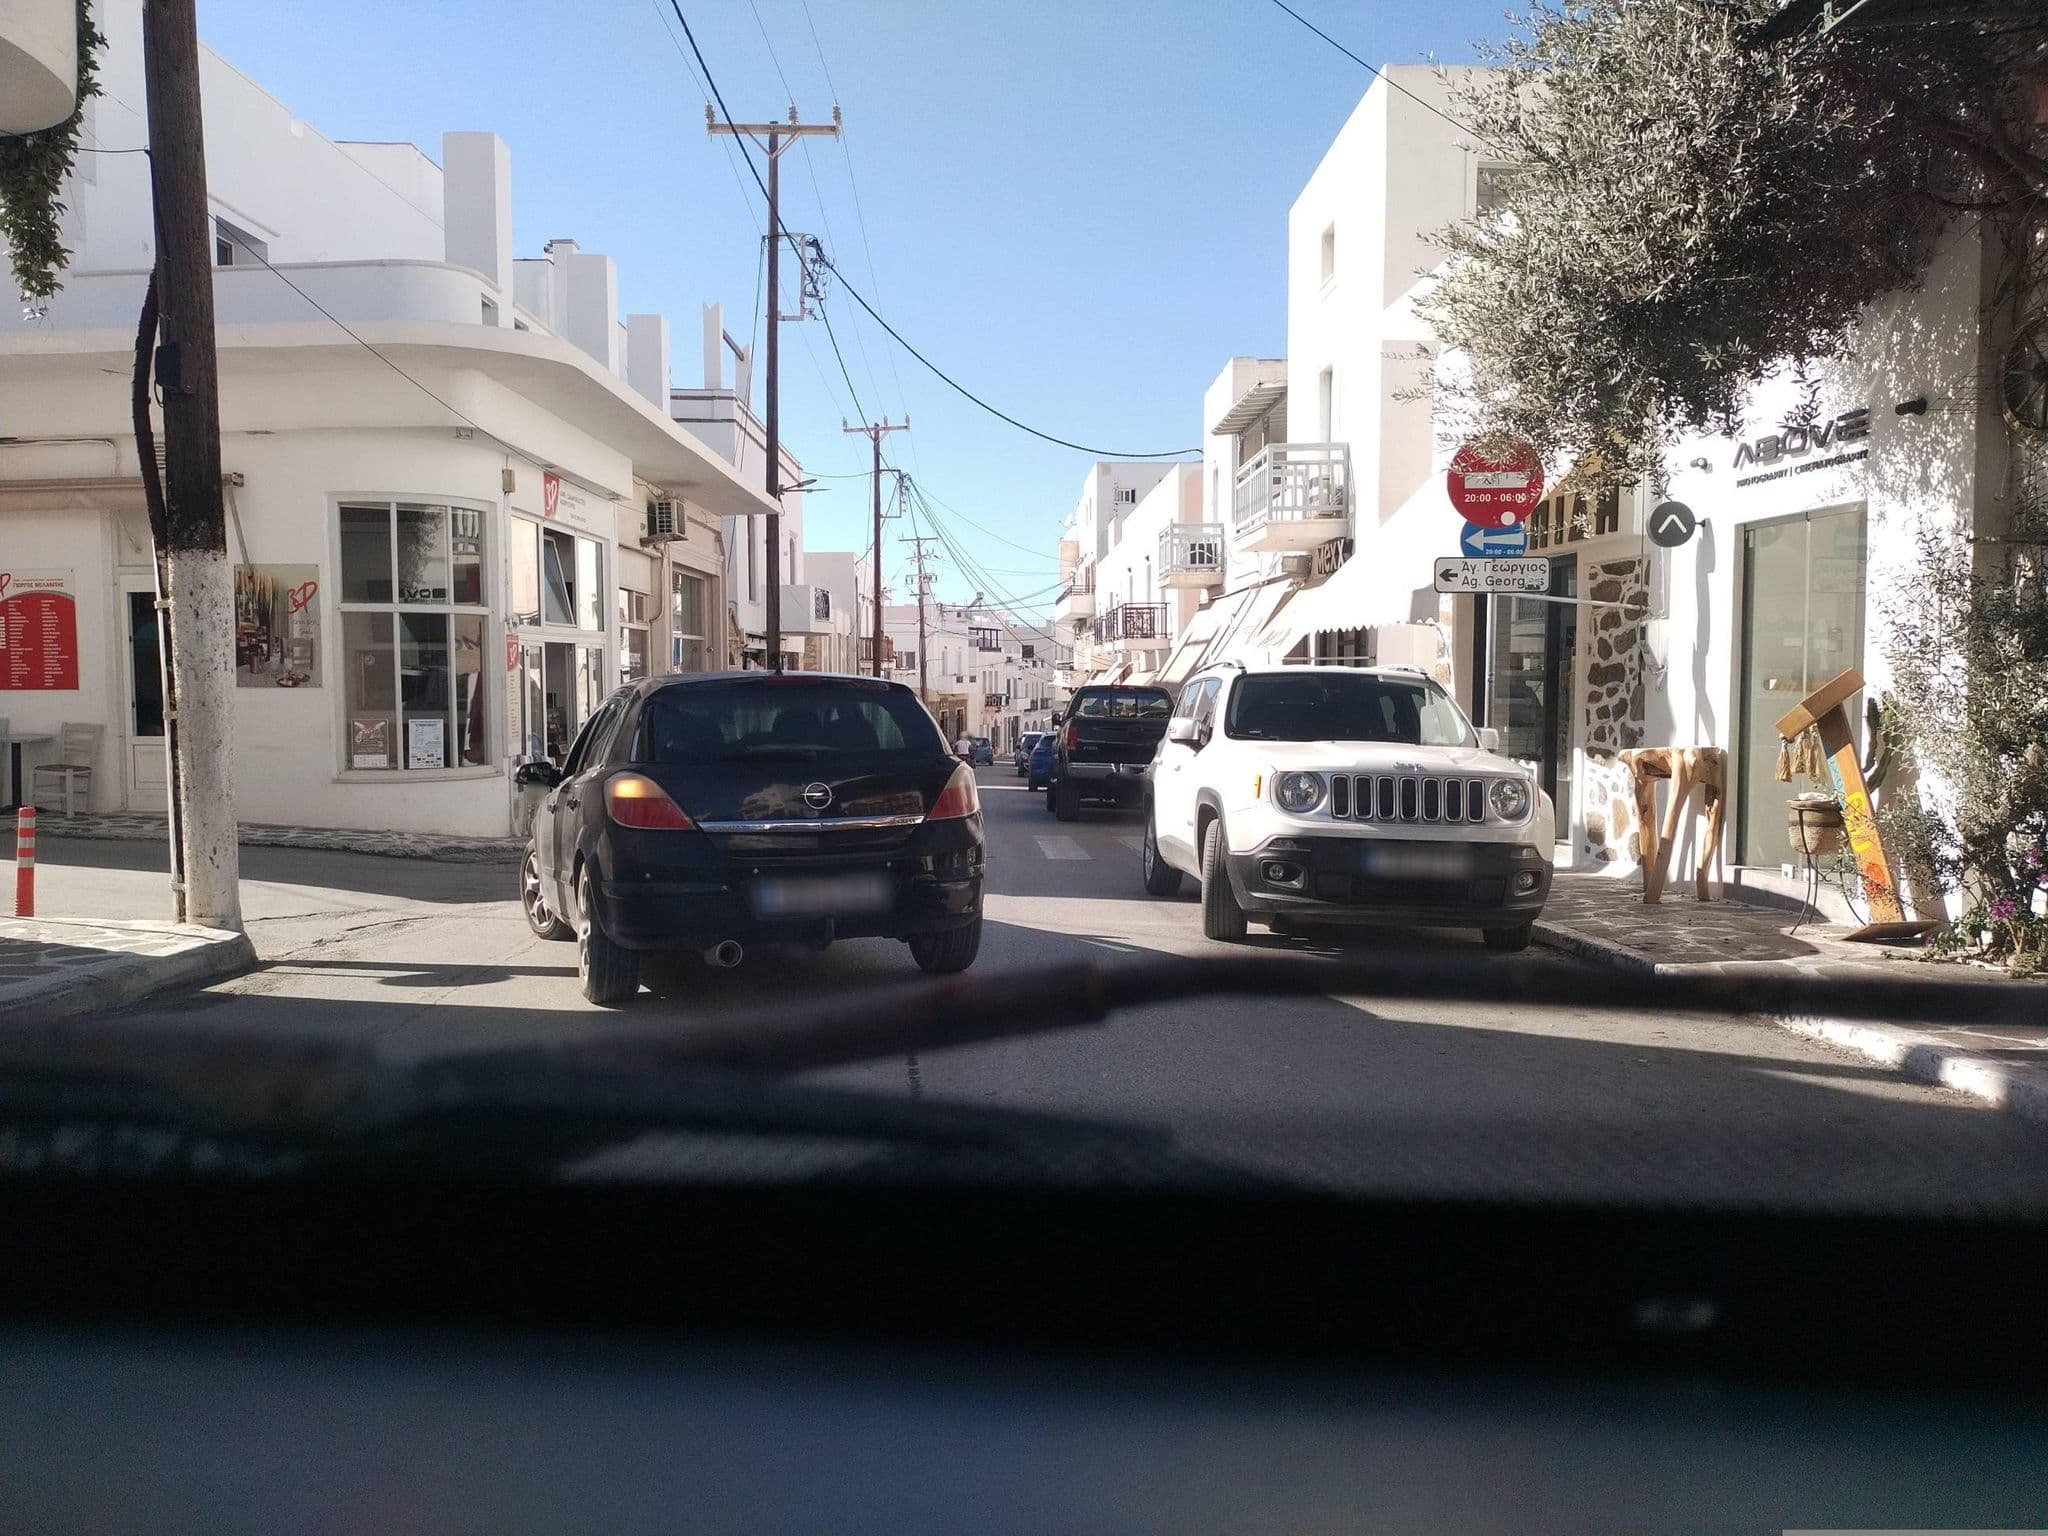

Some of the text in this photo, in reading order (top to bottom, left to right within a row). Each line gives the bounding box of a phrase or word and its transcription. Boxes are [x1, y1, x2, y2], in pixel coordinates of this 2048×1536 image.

[1464, 493, 1491, 503] 20:00
[1500, 493, 1527, 503] 06:00
[1484, 561, 1547, 575] Γεώργιος
[1461, 576, 1481, 589] Ag.
